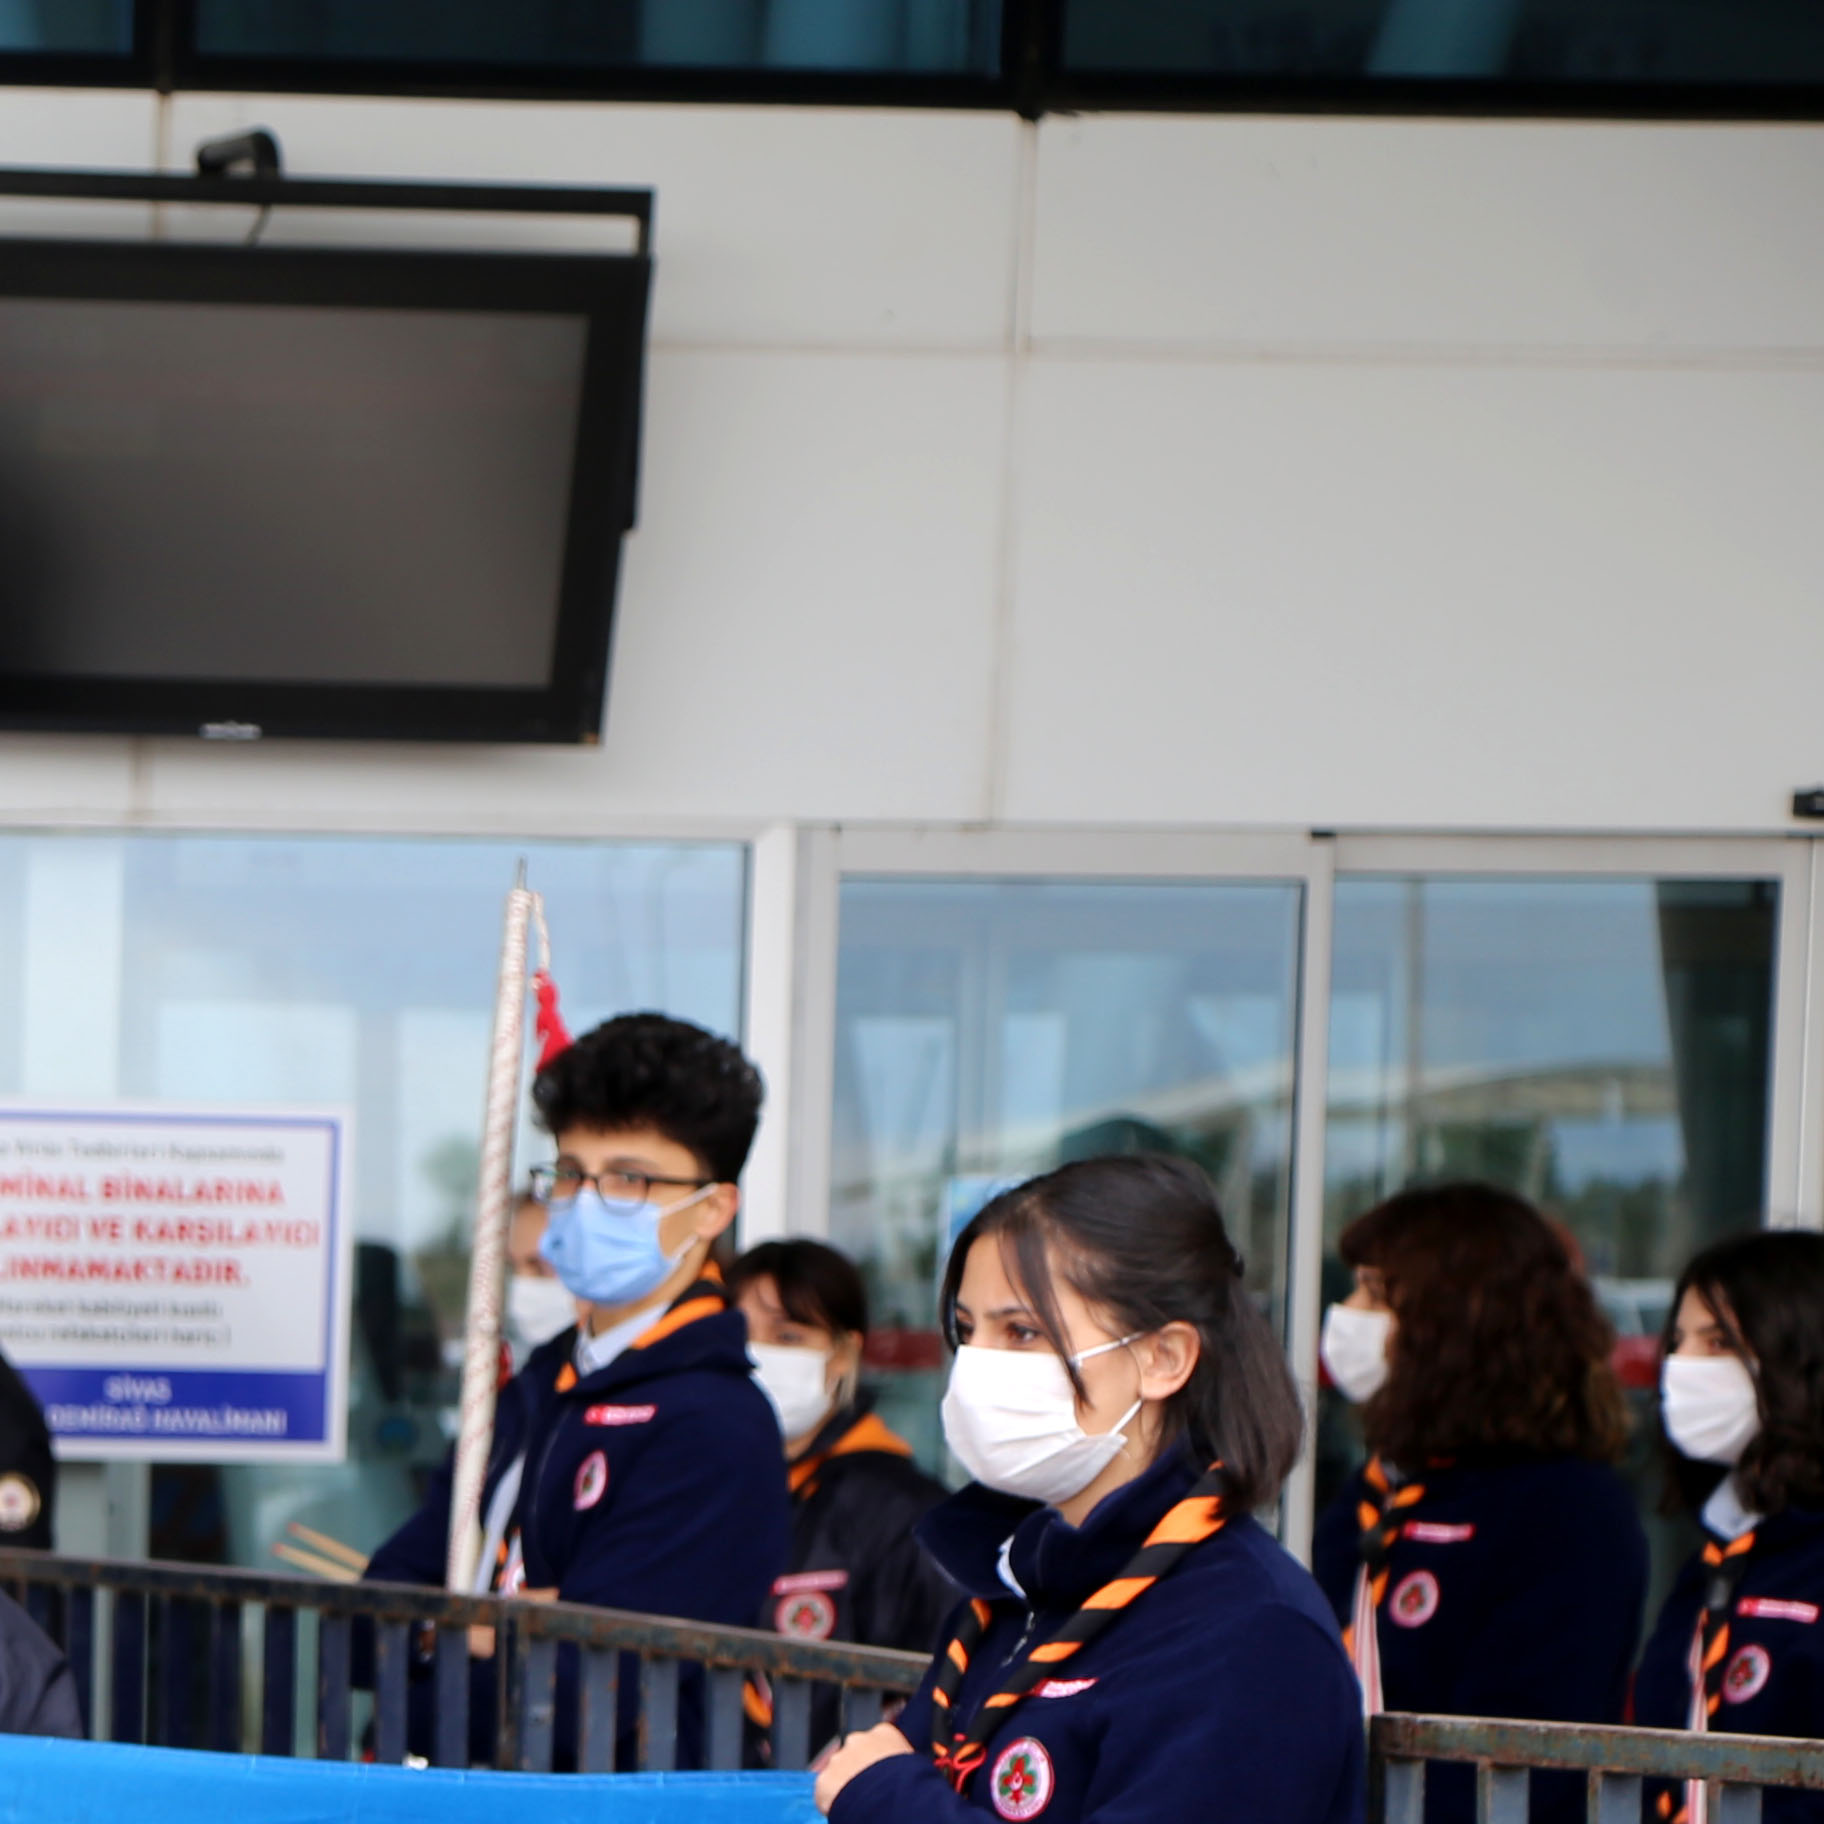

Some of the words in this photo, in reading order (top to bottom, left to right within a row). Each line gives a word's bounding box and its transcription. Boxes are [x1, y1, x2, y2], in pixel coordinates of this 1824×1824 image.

[99, 1169, 285, 1208] BİNALARINA
[88, 1215, 123, 1243] VE
[105, 1374, 172, 1403] SİVAS
[153, 1404, 288, 1436] HAVALİMANI
